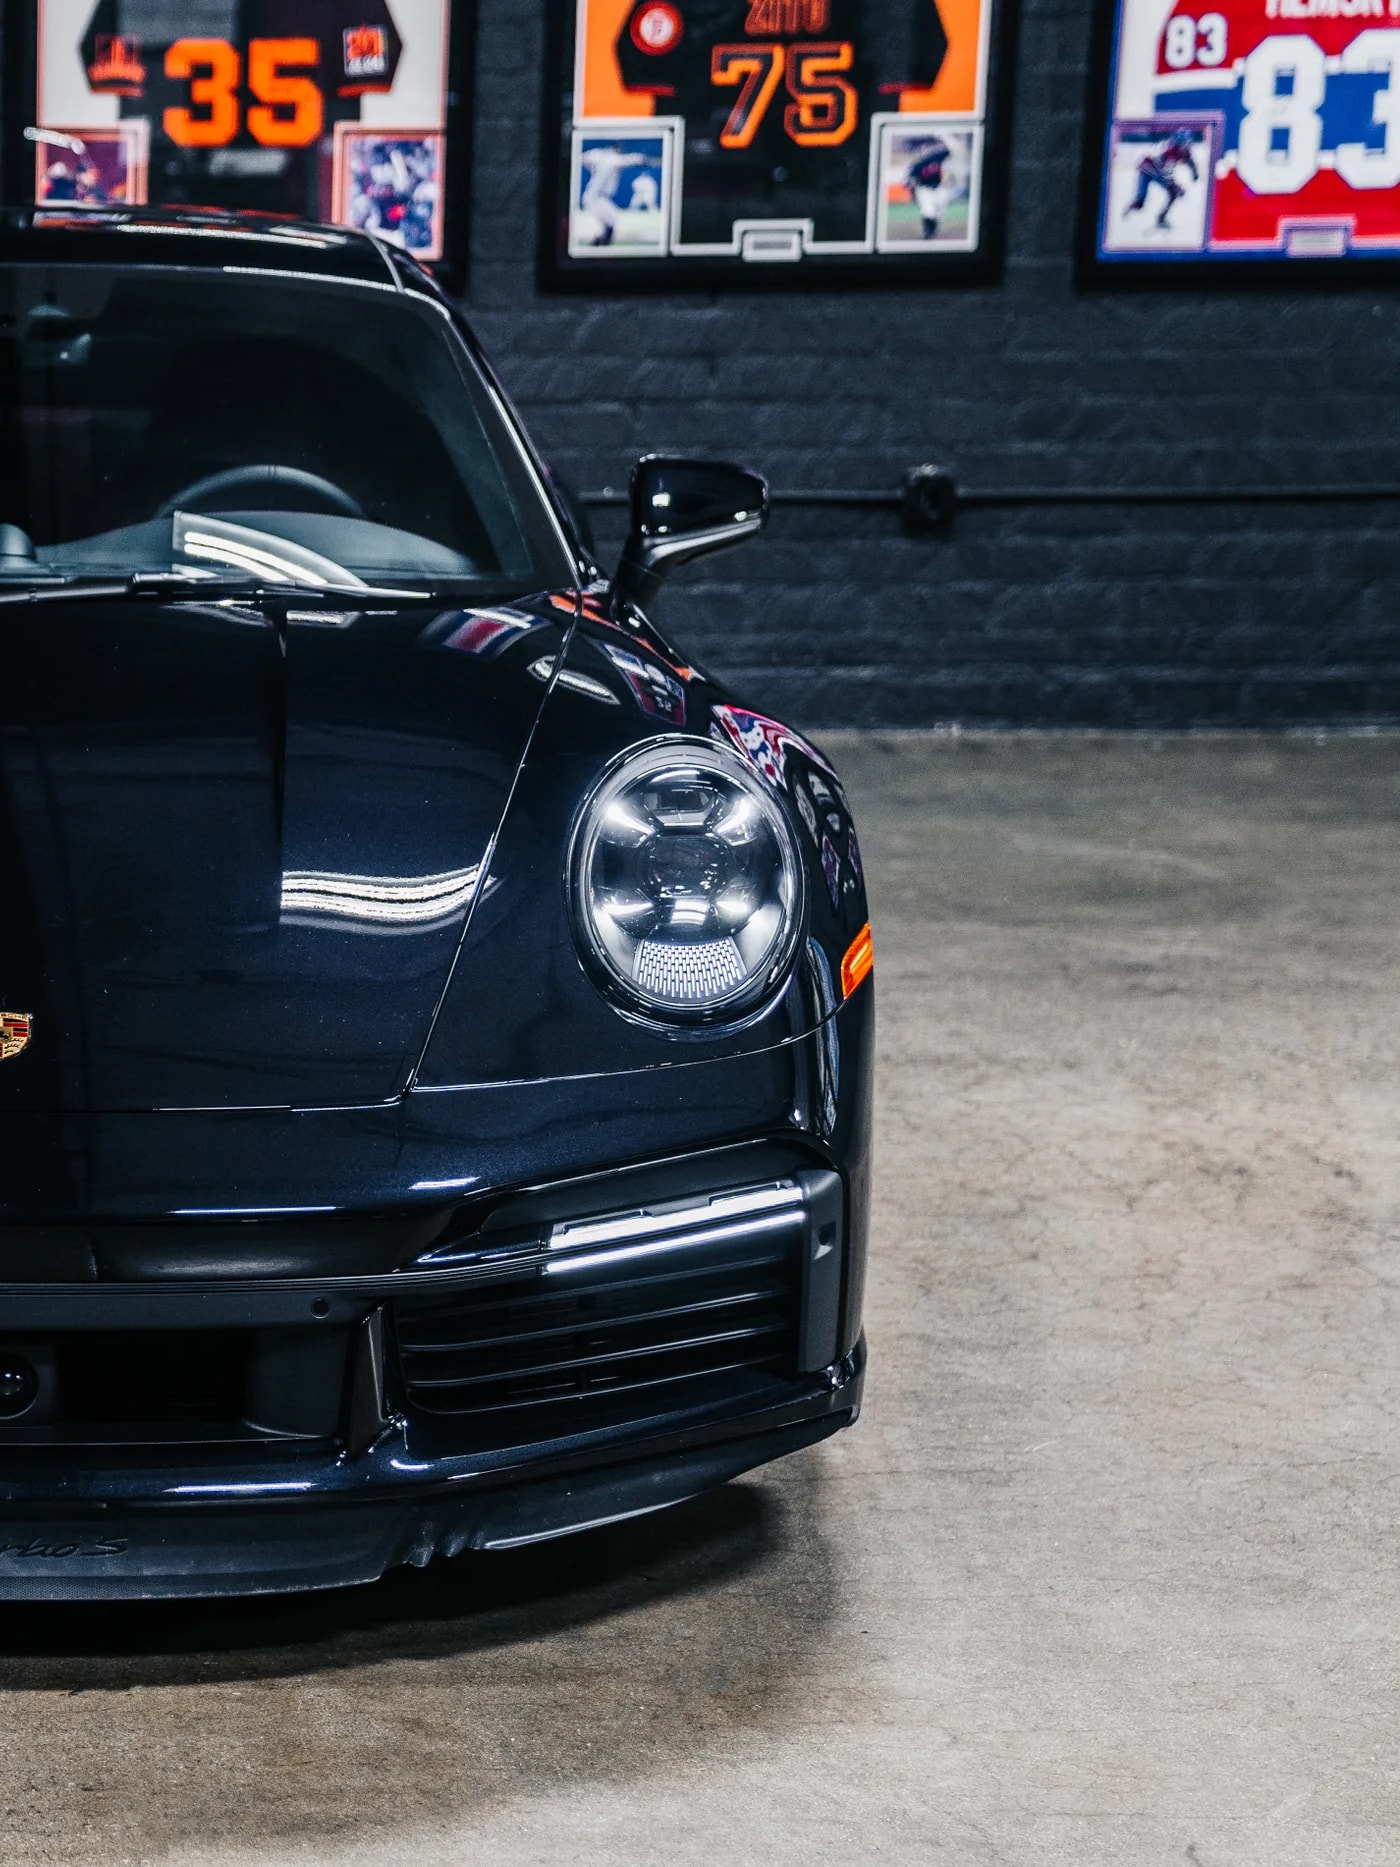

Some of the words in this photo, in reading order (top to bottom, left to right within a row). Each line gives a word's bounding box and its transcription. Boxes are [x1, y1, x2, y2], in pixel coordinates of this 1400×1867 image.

[163, 38, 324, 148] 35
[1165, 13, 1228, 68] 83
[710, 42, 859, 148] 75
[1237, 28, 1400, 195] 83
[81, 1536, 129, 1557] S
